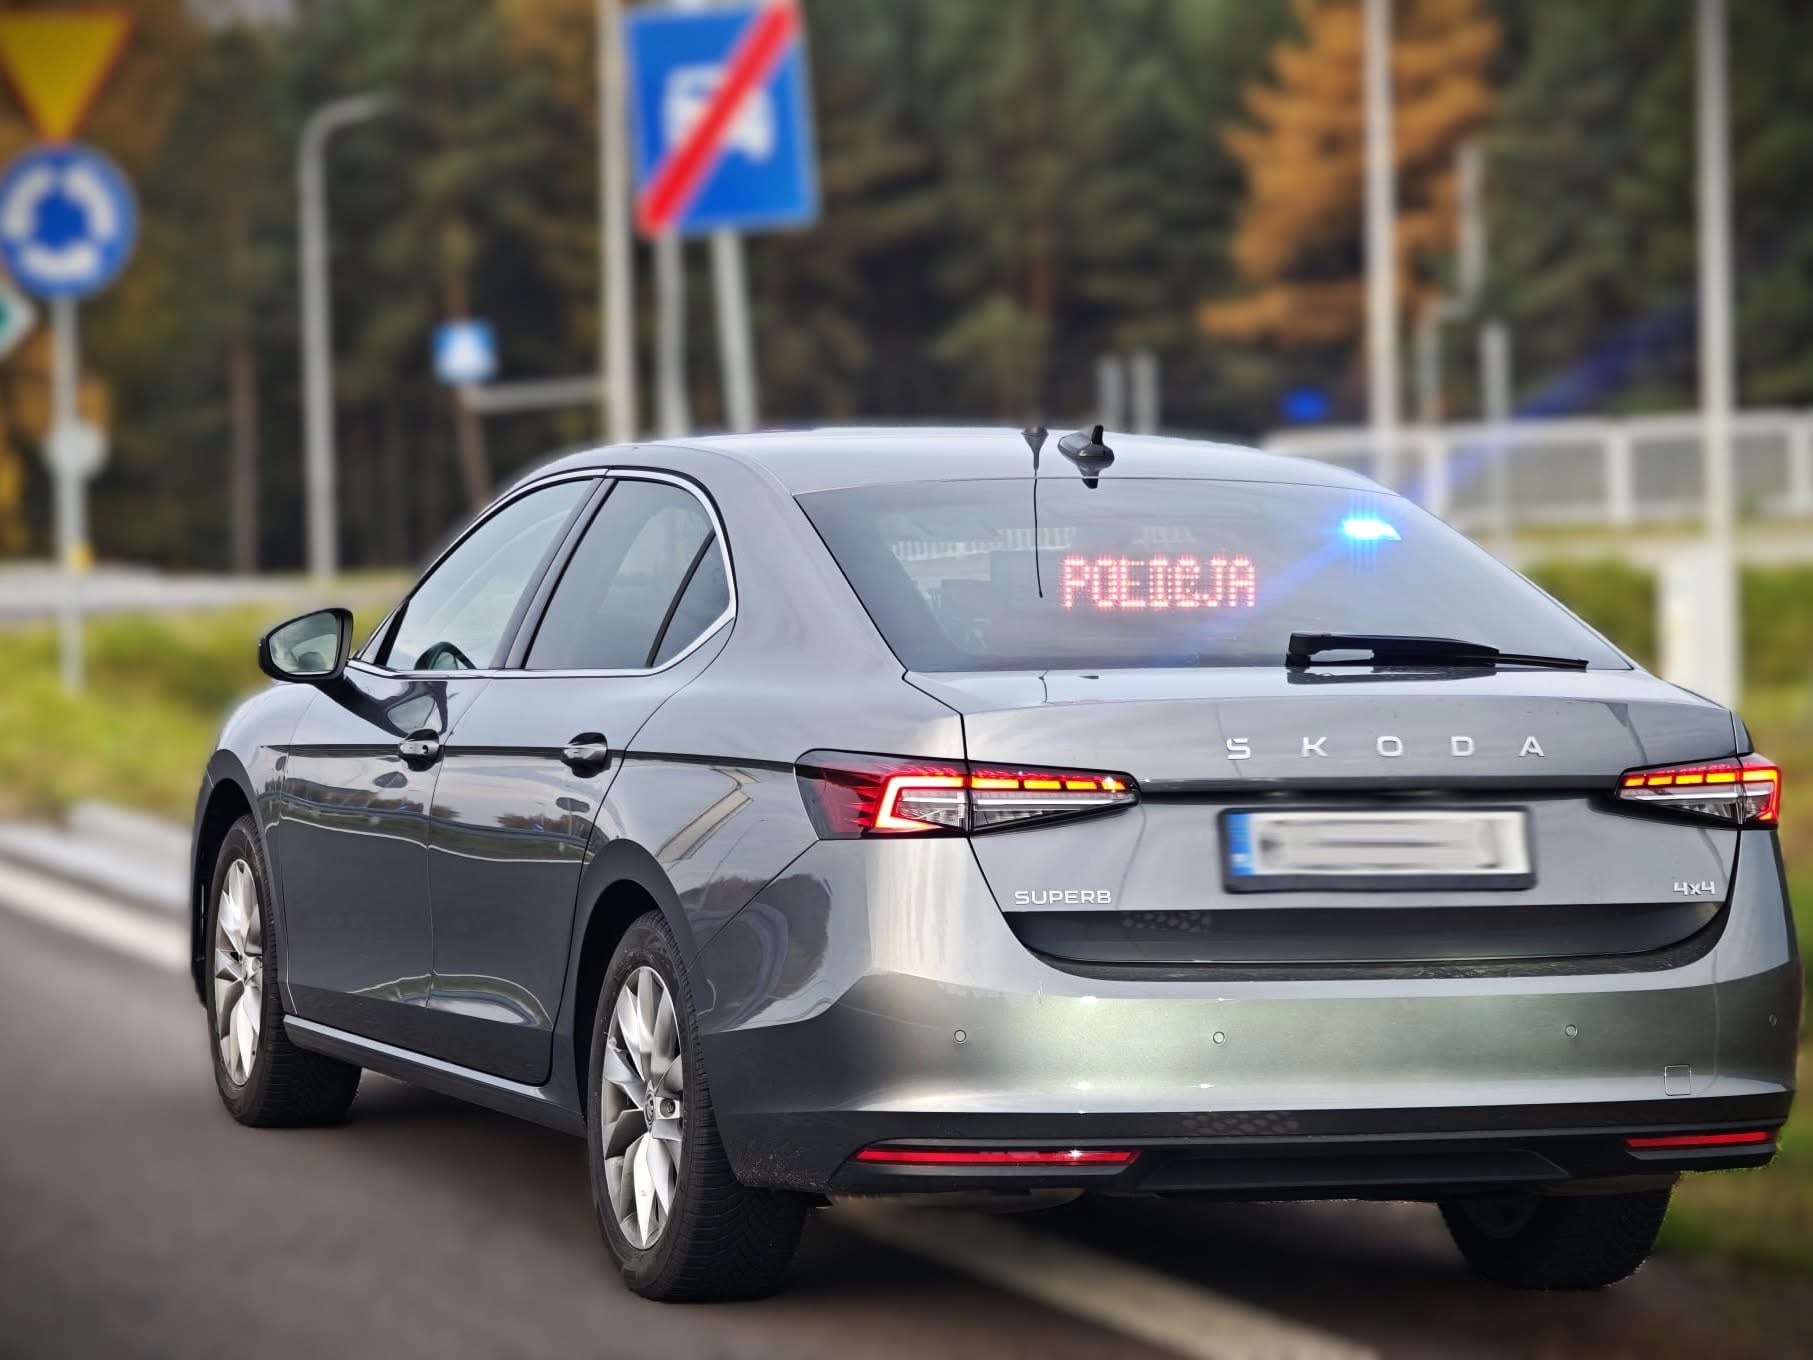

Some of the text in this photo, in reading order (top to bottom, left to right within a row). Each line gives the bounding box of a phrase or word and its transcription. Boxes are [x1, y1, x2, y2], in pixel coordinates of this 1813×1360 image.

[1226, 736, 1546, 760] SKODA
[1673, 881, 1717, 896] 4x4
[1014, 889, 1112, 905] SUPERB
